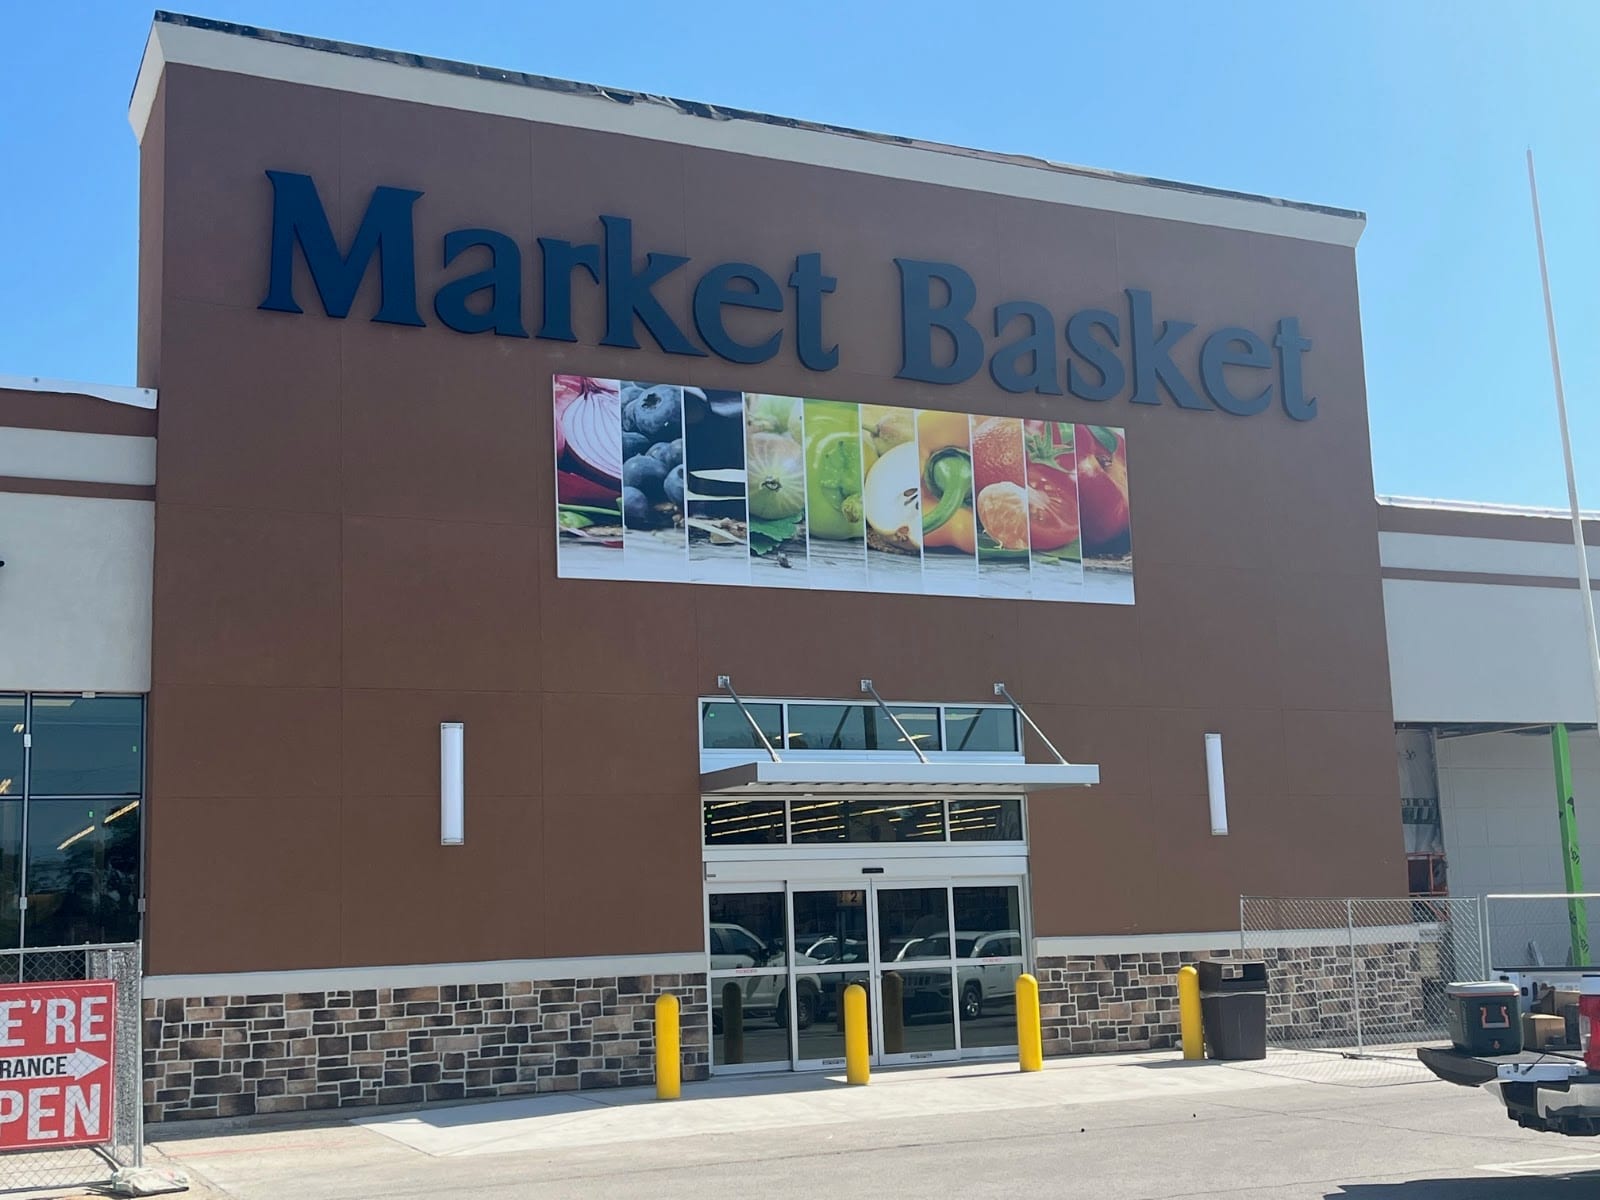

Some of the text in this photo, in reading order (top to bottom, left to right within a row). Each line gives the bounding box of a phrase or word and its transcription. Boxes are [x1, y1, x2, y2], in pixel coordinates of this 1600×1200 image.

[257, 169, 1318, 422] Market Basket
[850, 891, 858, 903] 2
[0, 997, 107, 1046] E'RE
